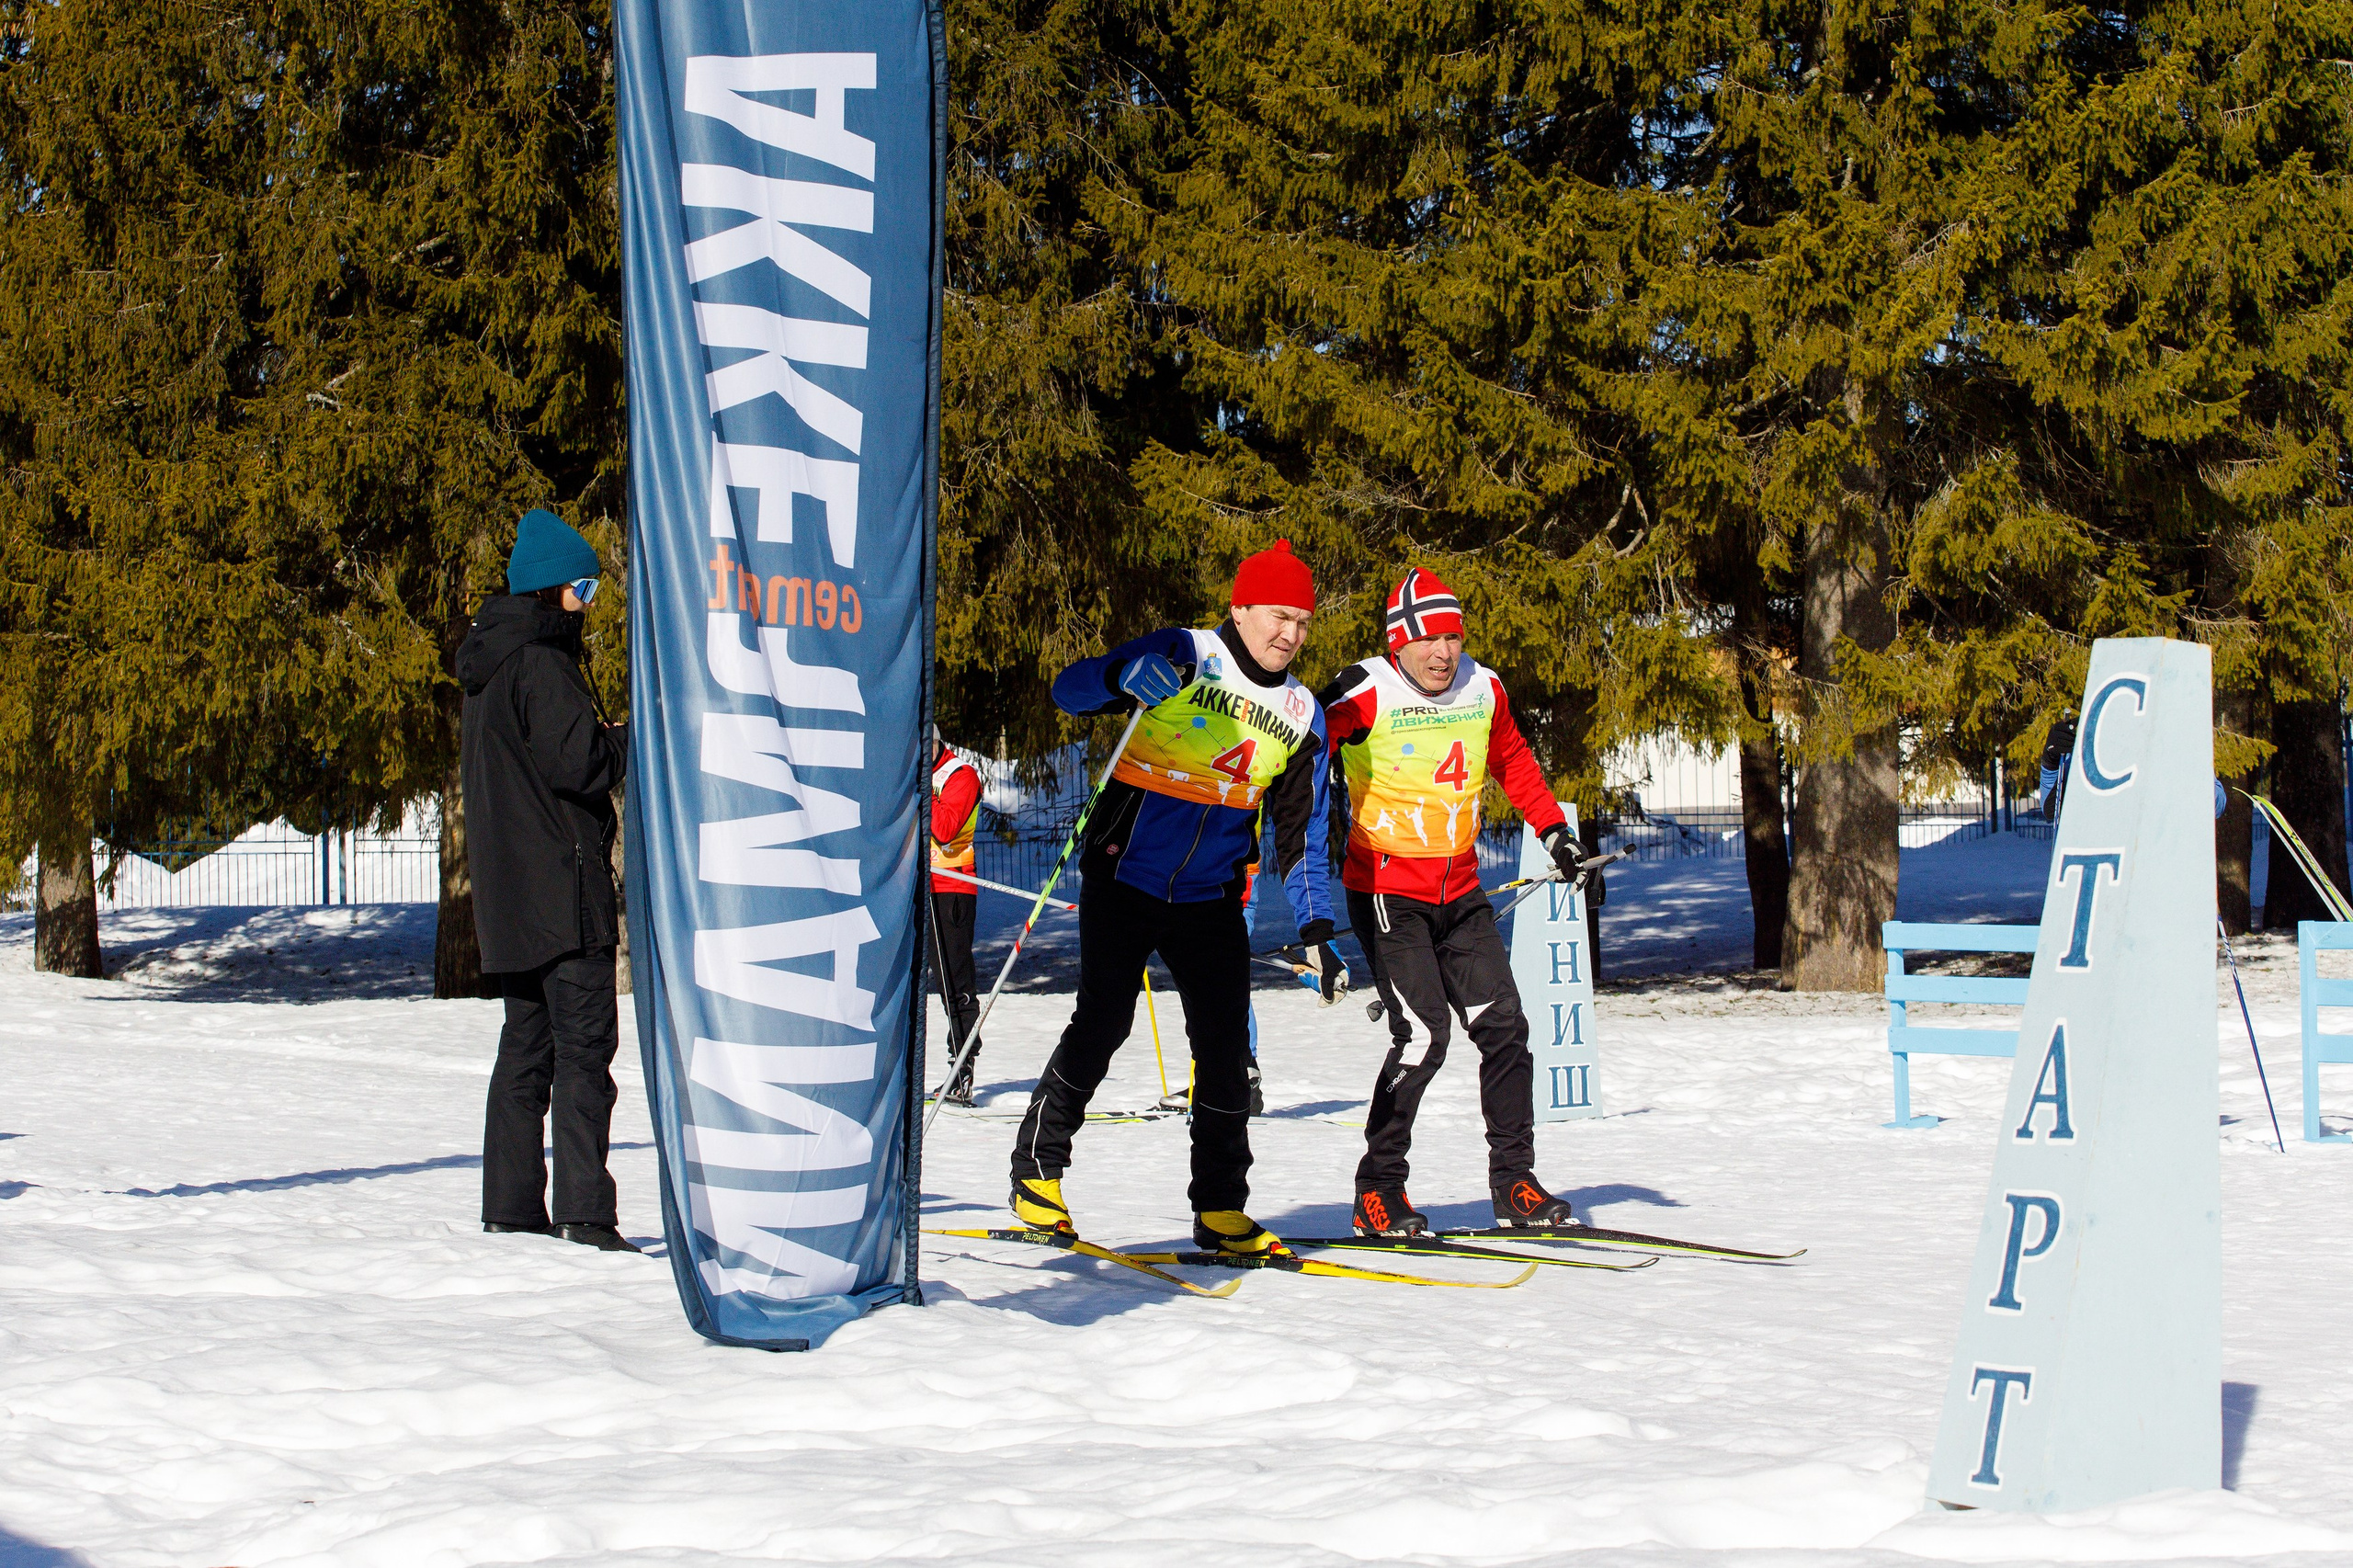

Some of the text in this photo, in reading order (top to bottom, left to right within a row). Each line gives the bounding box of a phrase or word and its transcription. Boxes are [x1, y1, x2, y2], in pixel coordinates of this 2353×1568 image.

[1188, 686, 1300, 752] AKKERMANN
[1391, 707, 1438, 717] #PRO
[1211, 737, 1257, 783] 4
[1433, 739, 1470, 792] 4
[983, 881, 1023, 895] AVANTI
[1969, 676, 2148, 1489] СТАРТ
[1022, 1232, 1051, 1244] PELTONEN
[1227, 1256, 1267, 1268] PELTONEN
